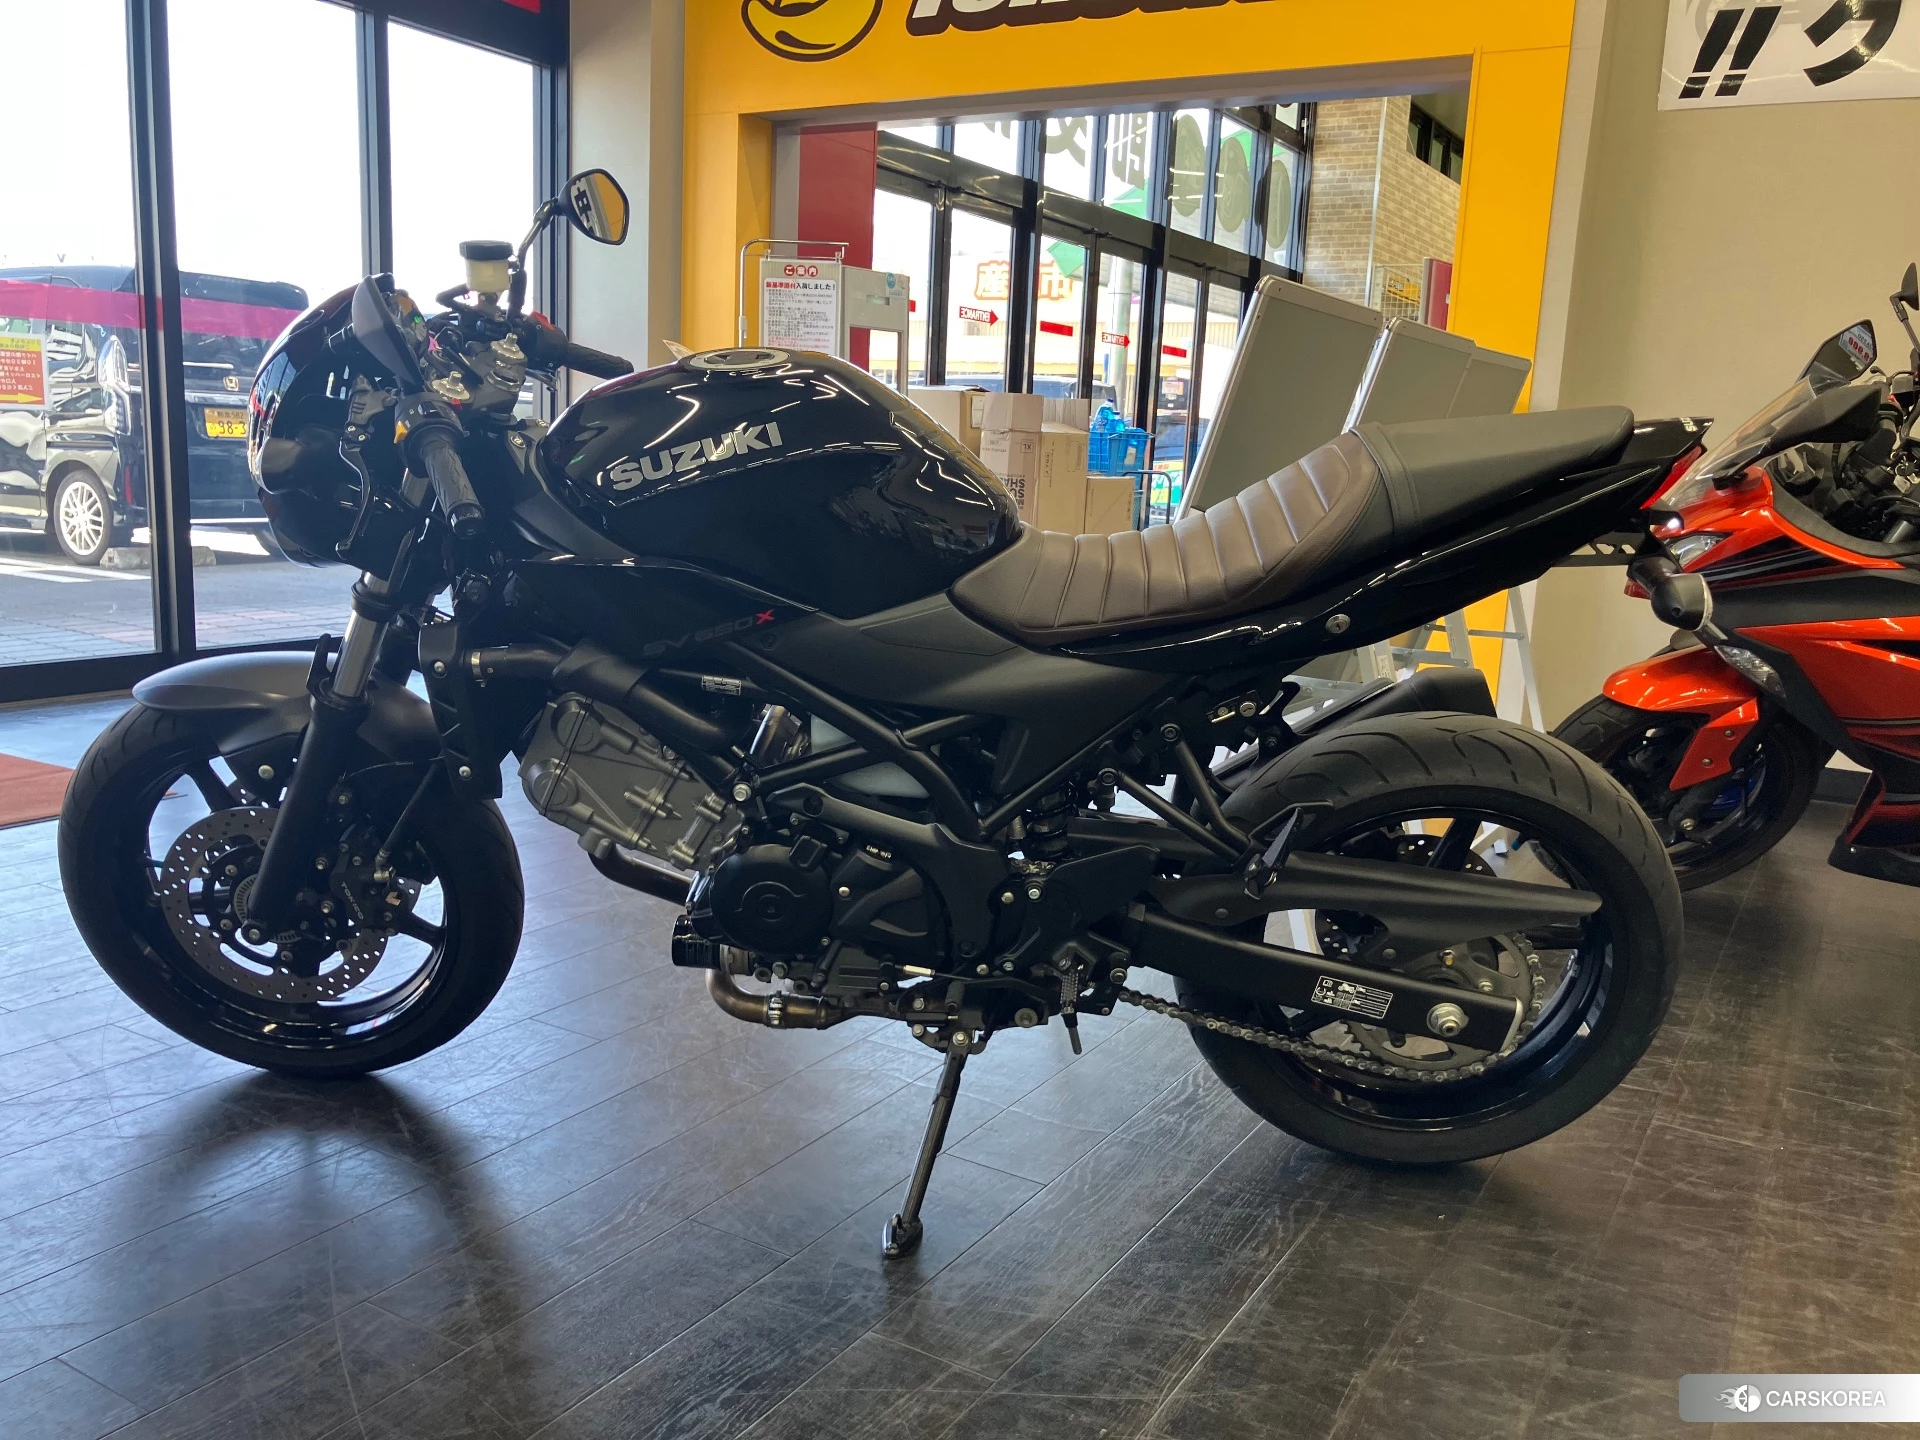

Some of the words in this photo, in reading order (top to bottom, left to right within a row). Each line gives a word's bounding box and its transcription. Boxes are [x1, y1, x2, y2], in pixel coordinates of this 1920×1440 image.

[974, 260, 1075, 301] 産市
[610, 421, 784, 491] SUZUKI
[643, 609, 776, 658] SV650X
